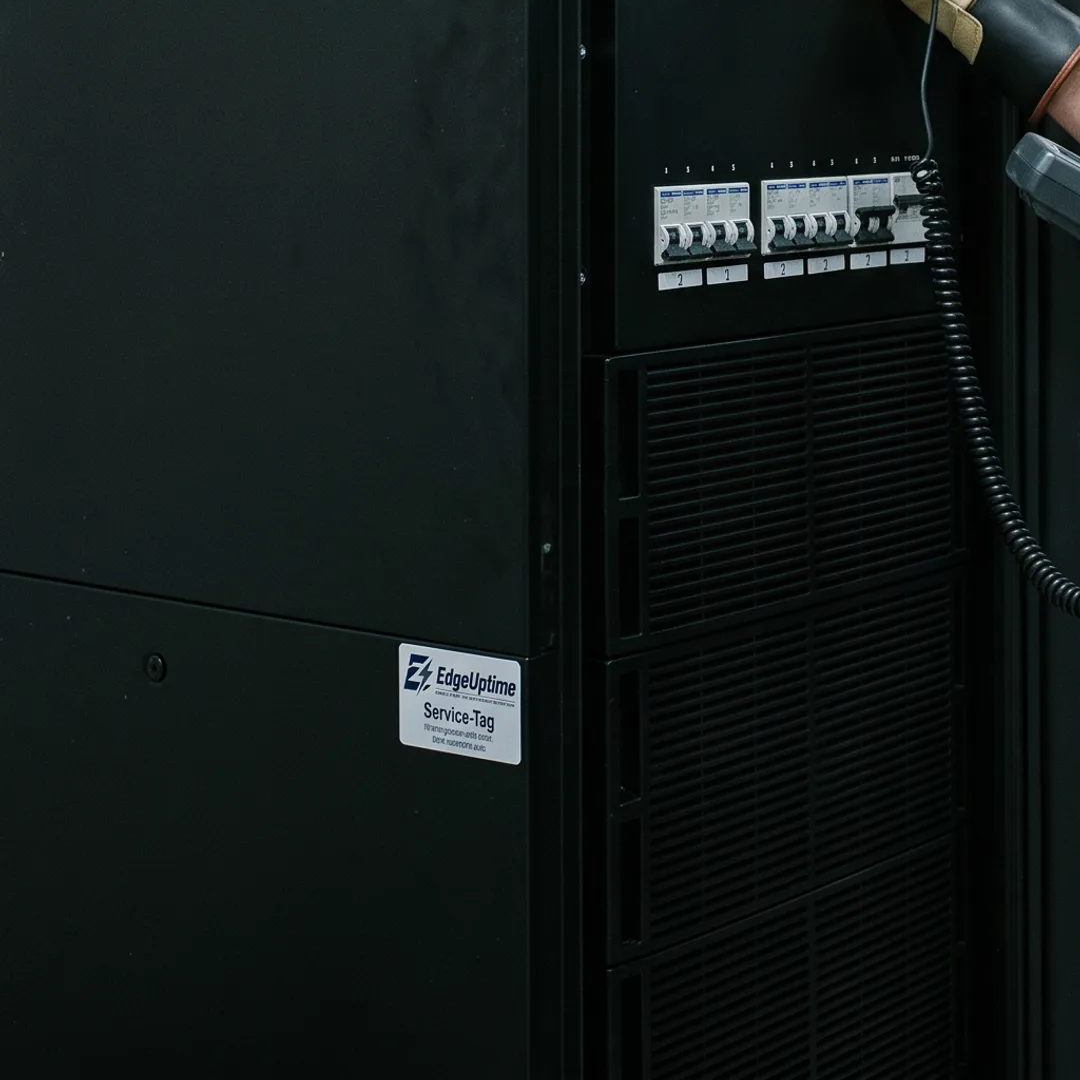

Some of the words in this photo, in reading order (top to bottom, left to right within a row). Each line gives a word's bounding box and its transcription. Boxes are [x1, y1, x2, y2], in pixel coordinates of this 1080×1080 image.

[677, 273, 683, 286] 2
[780, 262, 786, 276] 2
[436, 666, 516, 697] EdgeUptime
[424, 701, 495, 733] Service-Tag
